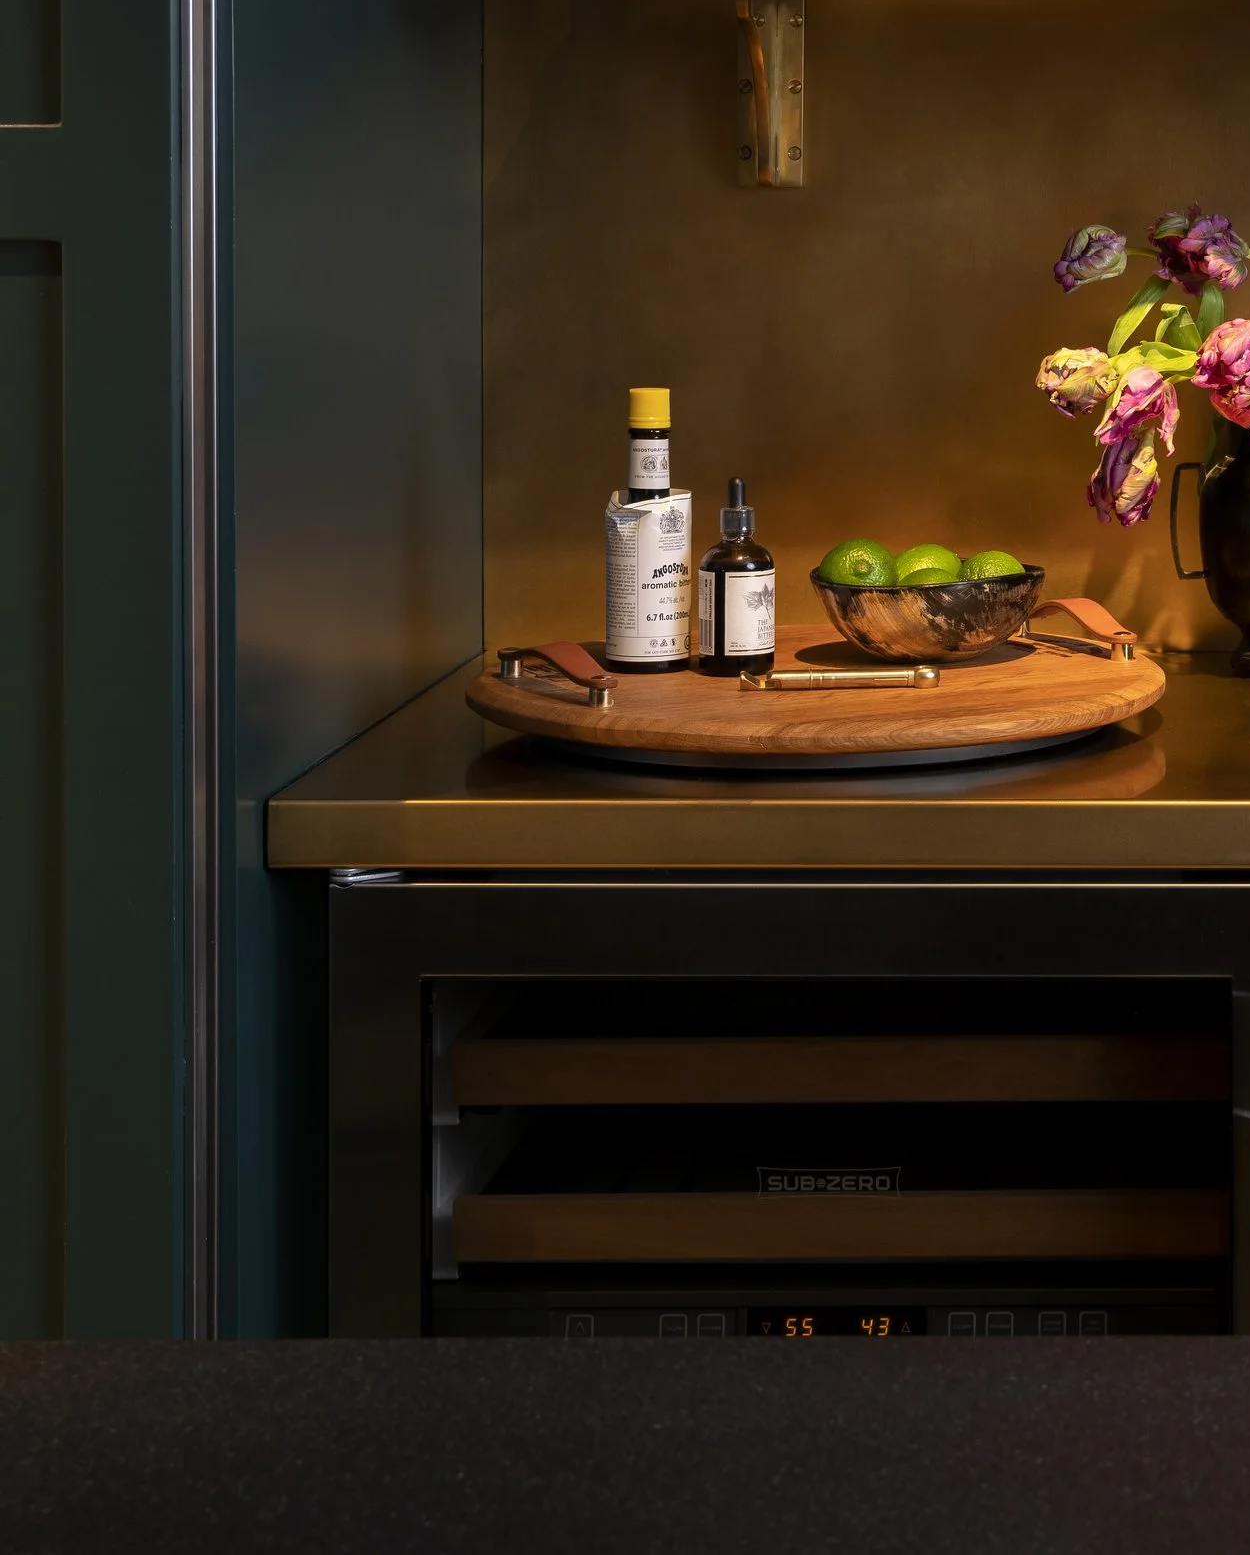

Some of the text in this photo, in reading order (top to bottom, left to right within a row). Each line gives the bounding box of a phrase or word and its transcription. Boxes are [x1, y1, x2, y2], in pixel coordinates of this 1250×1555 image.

[641, 581, 677, 589] aromatic
[646, 613, 657, 622] 6.7
[659, 612, 673, 621] fl.oz
[826, 1175, 892, 1191] ZERO
[786, 1318, 813, 1337] 55
[862, 1317, 890, 1336] 43
